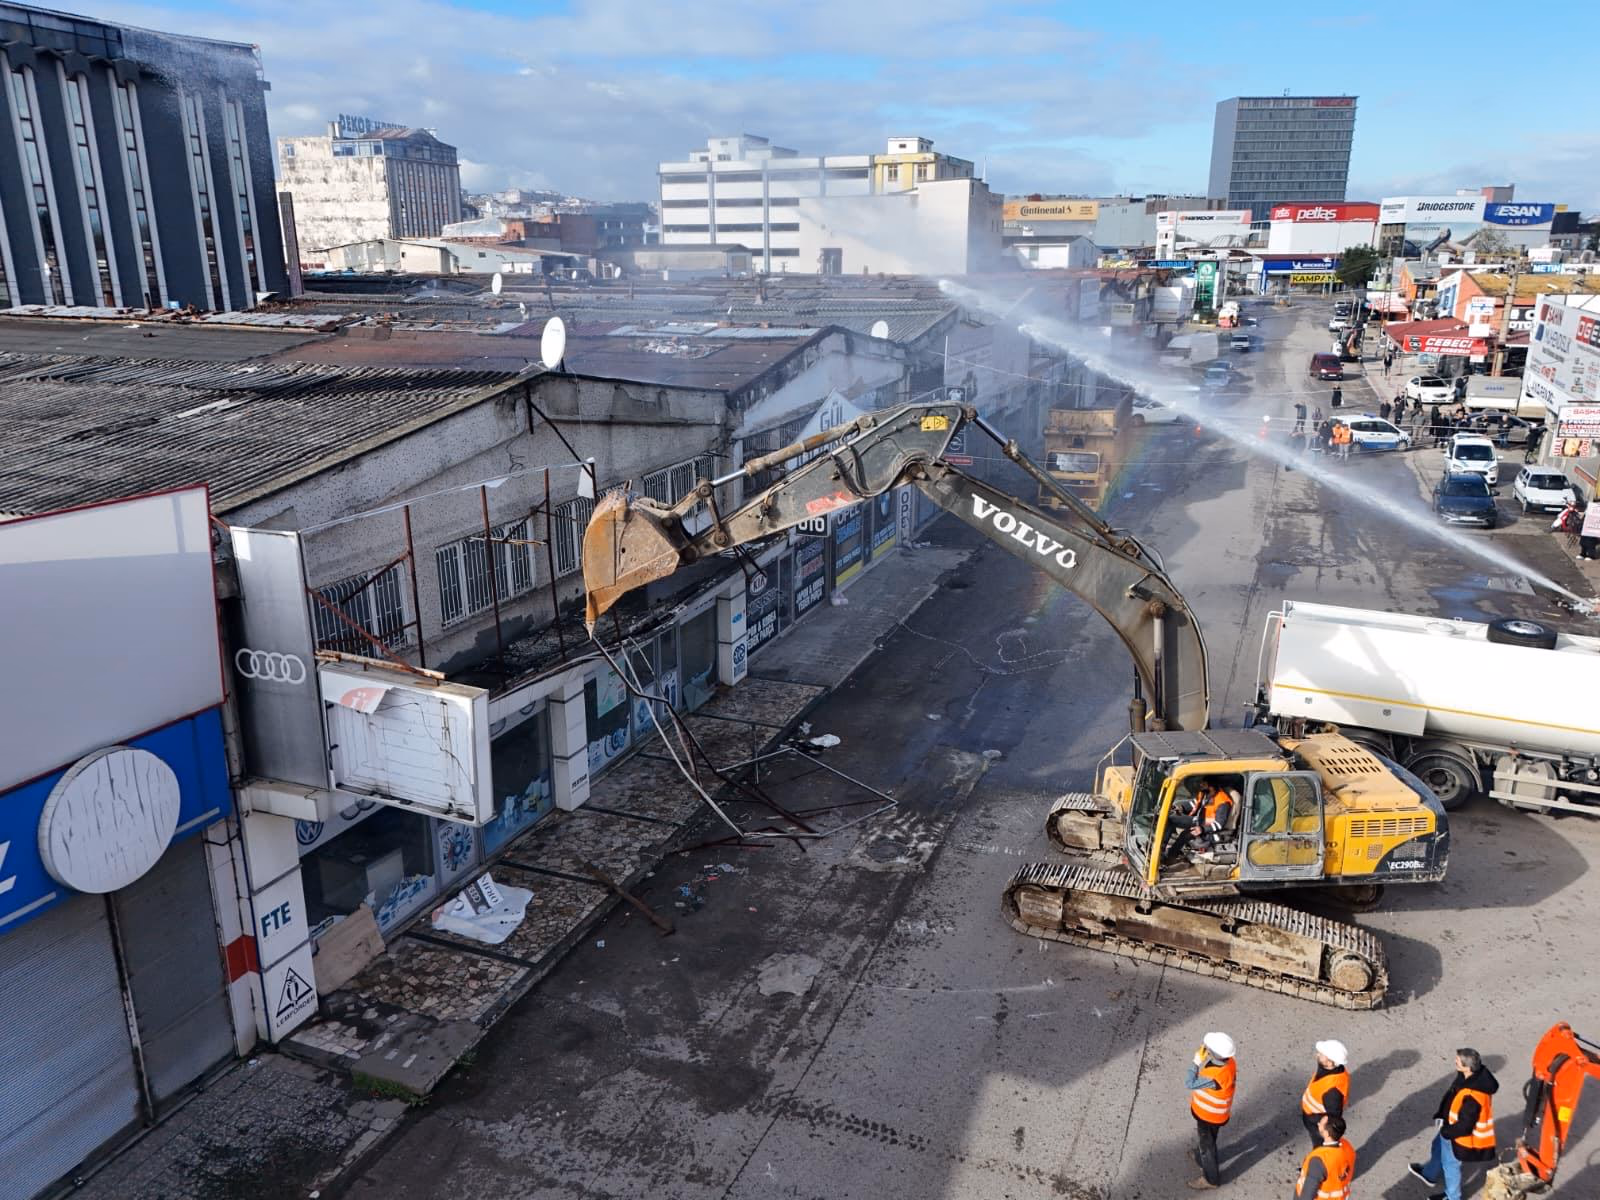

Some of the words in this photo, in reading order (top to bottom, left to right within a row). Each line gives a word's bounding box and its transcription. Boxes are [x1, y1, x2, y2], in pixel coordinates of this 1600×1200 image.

[1020, 205, 1066, 217] Continental
[1417, 202, 1476, 211] BRIDGESTONE
[1498, 206, 1542, 217] ESAN
[971, 493, 1079, 570] VOLVO
[752, 572, 767, 592] KIA
[260, 901, 291, 938] FTE
